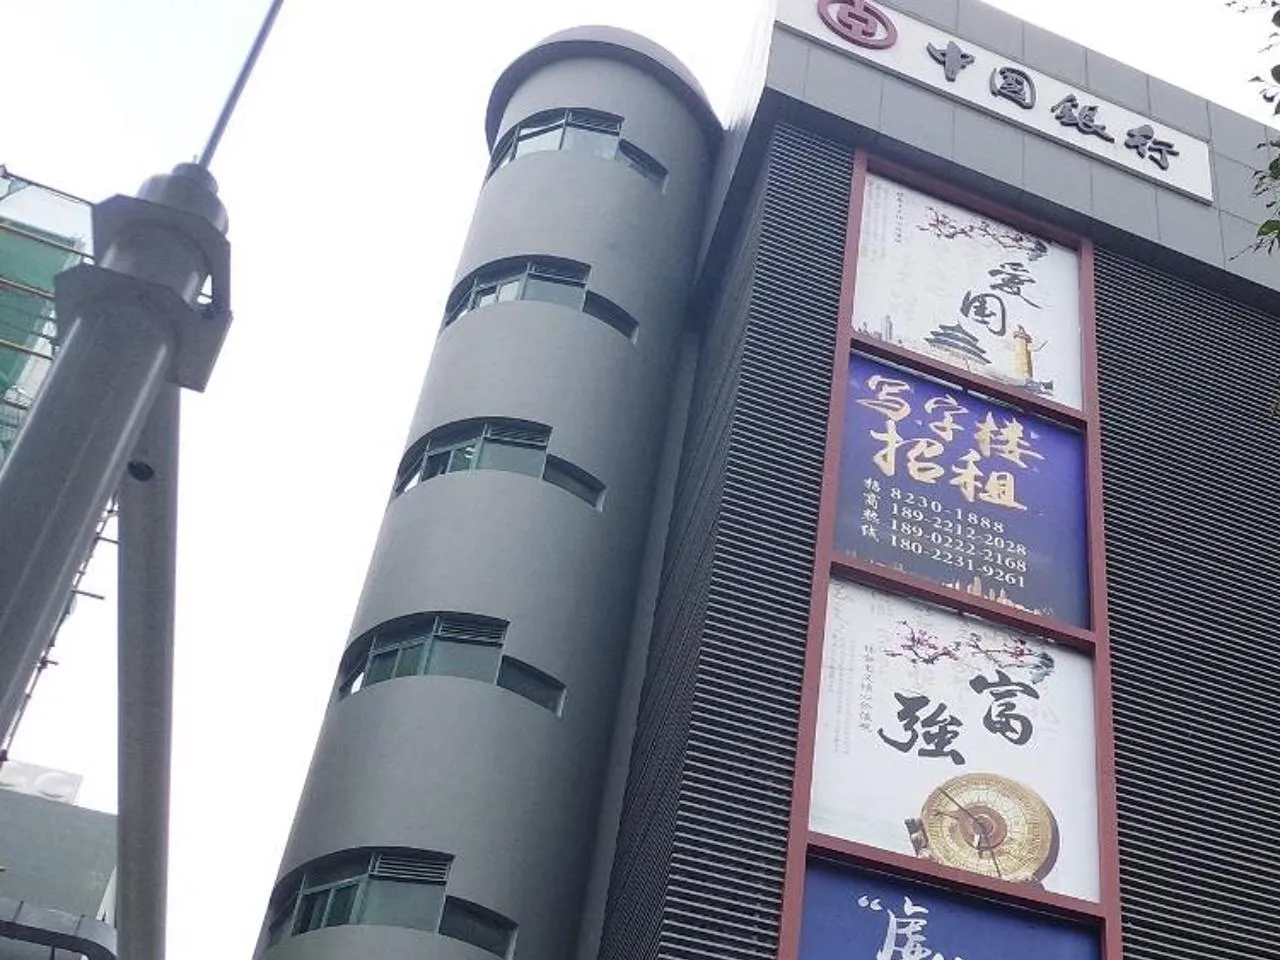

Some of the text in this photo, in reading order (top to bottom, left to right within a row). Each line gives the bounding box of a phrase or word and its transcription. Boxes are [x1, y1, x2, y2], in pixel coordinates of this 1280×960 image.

[856, 375, 1044, 468] 写字楼
[869, 420, 1028, 511] 招租
[890, 488, 1004, 533] 8230-1888
[891, 503, 1027, 555] 189-2212-2028
[891, 519, 1027, 572] 189-0222-2168
[891, 535, 1025, 587] 180-2231-9261
